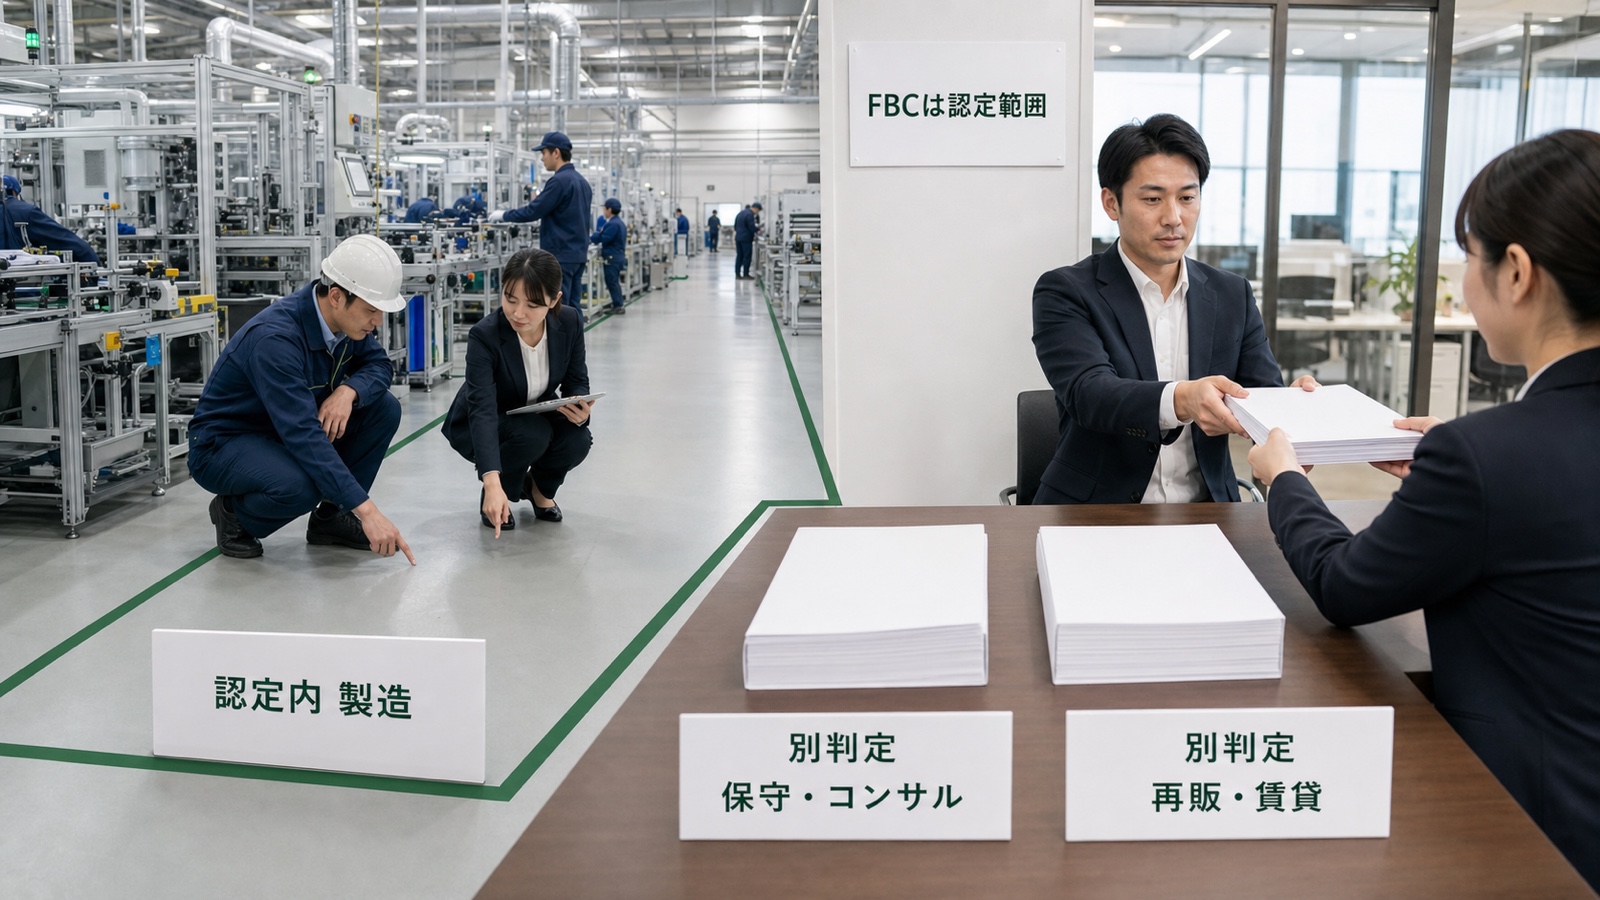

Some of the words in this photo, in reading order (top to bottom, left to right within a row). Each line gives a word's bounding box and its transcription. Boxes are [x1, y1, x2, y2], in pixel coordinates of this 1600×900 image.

[868, 92, 1047, 118] FBCは認定範囲
[214, 675, 321, 714] 認定内
[339, 681, 412, 720] 製造
[788, 731, 896, 763] 別判定
[1185, 731, 1294, 763] 別判定
[721, 780, 963, 813] 保守・コンサル
[1151, 780, 1323, 813] 再販・賃貸
